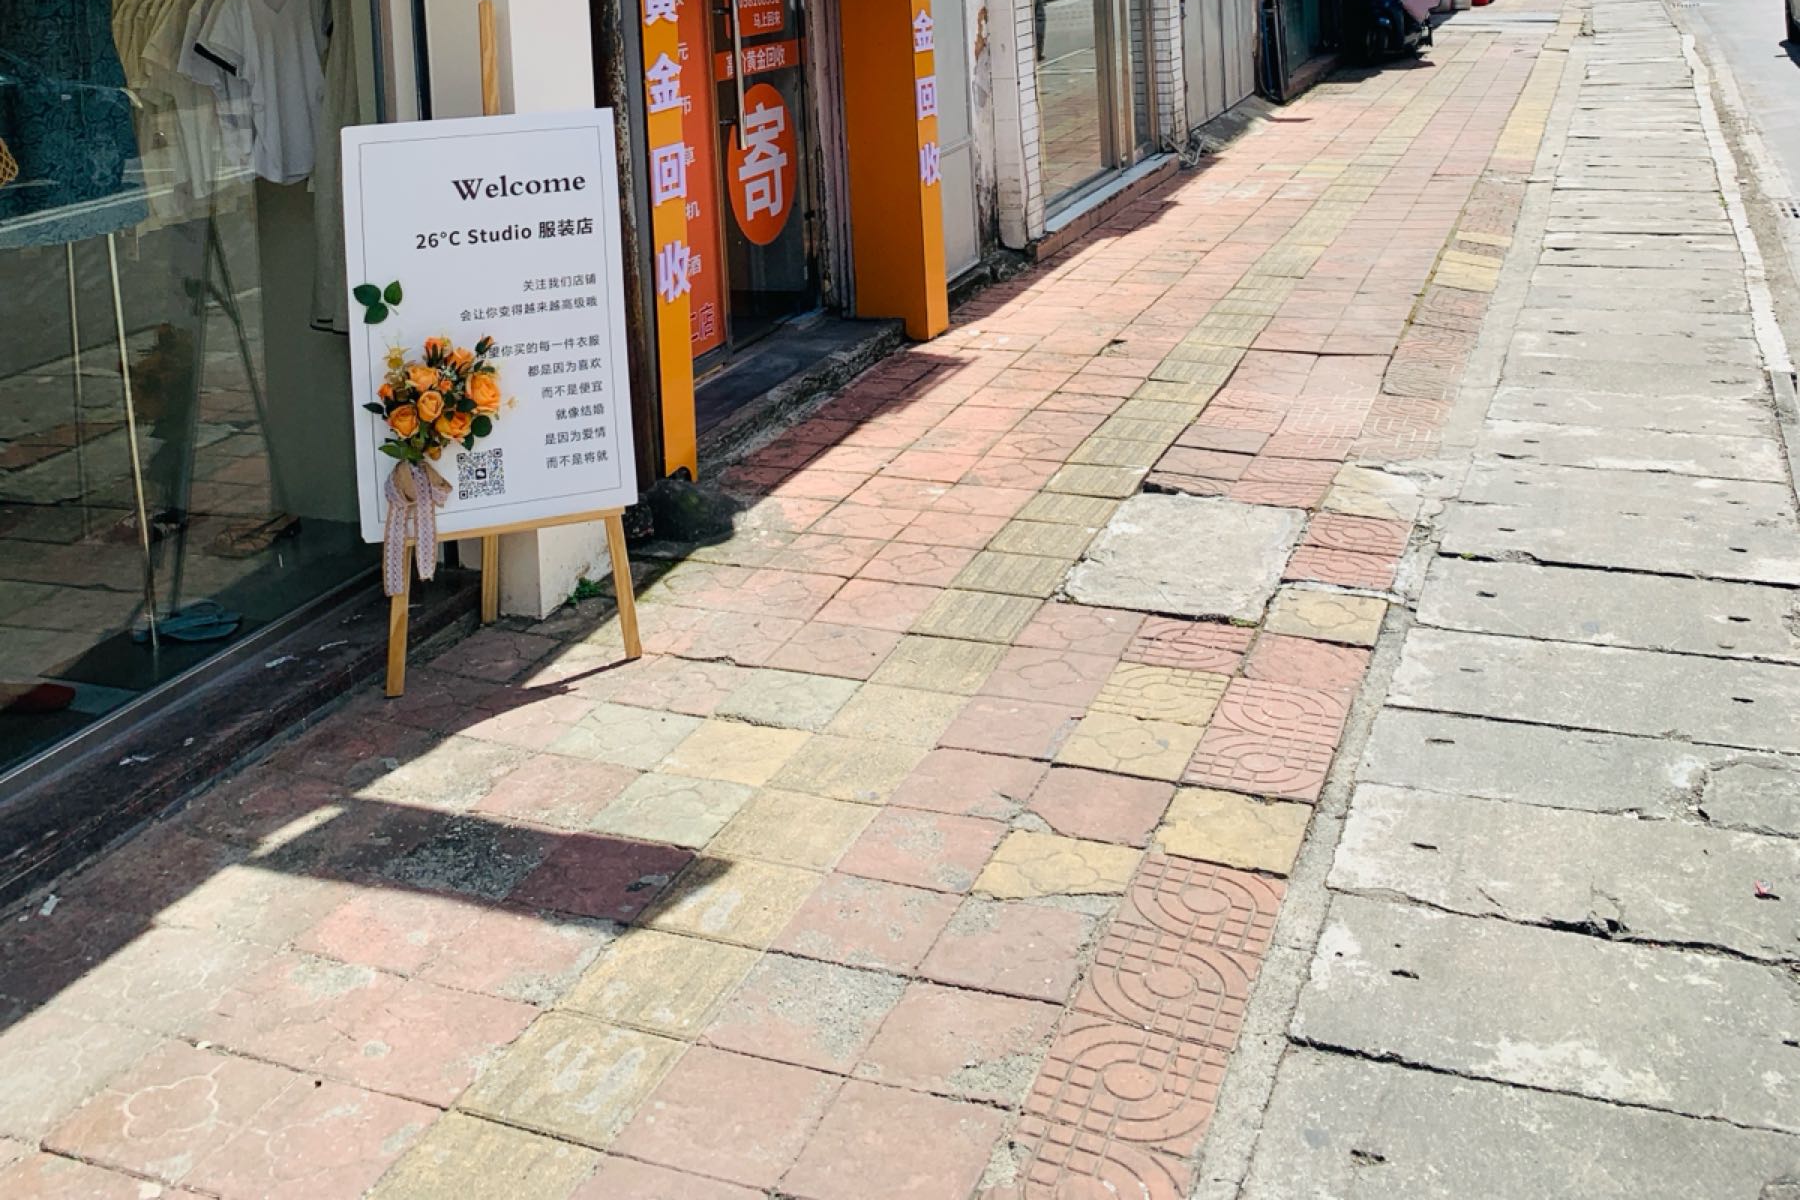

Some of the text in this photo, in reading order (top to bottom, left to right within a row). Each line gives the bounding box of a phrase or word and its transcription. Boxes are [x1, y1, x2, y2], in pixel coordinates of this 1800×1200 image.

[451, 174, 586, 201] Welcome
[416, 217, 594, 250] 26°C Studio 服装店
[523, 273, 597, 292] 关注我们店铺
[528, 357, 602, 378] 都是因为喜欢
[541, 381, 604, 399] 而不是便宜
[555, 403, 605, 421] 就像结婚
[545, 426, 607, 446] 是因为爱情
[546, 449, 608, 470] 而不是将就
